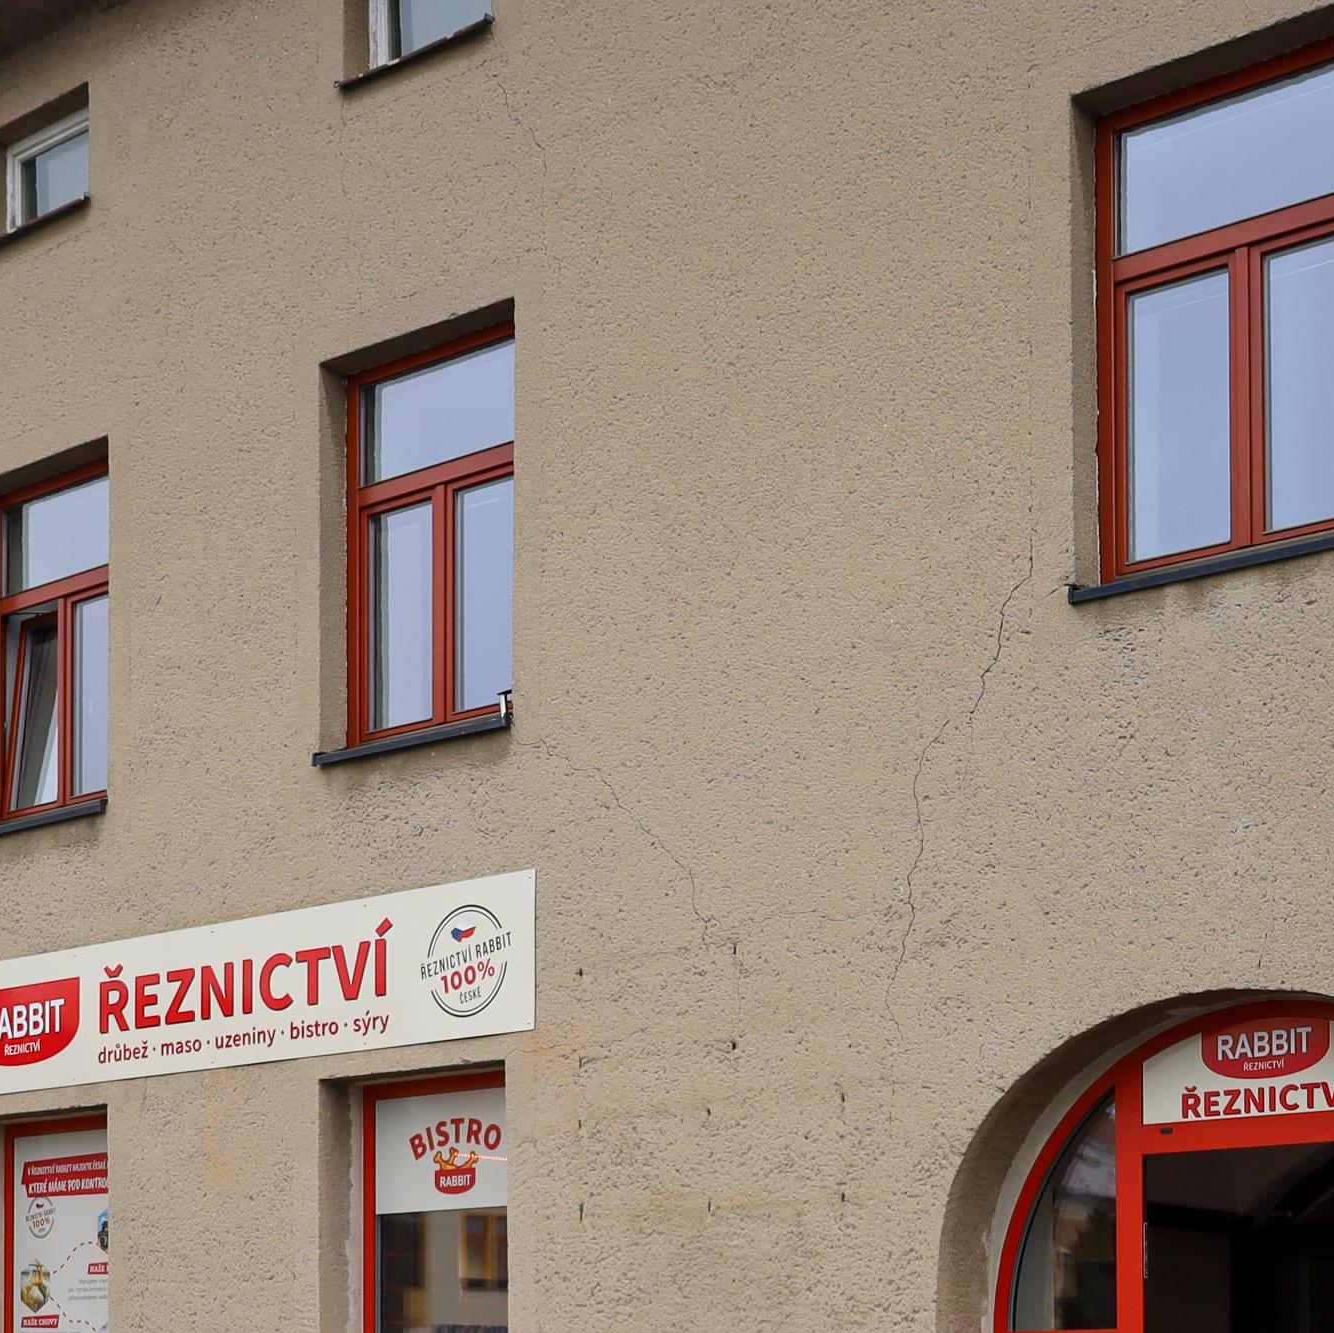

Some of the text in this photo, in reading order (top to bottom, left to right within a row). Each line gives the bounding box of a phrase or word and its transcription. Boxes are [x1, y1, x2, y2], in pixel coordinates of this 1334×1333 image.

[420, 931, 512, 981] ŘEZNICTVÍ RABBIT
[99, 917, 393, 1034] ŘEZNICTVÍ
[441, 957, 496, 994] 100%
[4, 1039, 41, 1057] ŘEZNICTVÍ
[98, 1010, 390, 1064] drůbež maso uzeniny bistro sýry
[1217, 1026, 1312, 1062] RABBIT
[1243, 1058, 1285, 1072] ŘEZNICTVÍ
[409, 1117, 502, 1161] BISTRO
[28, 1179, 47, 1194] KTERÉ
[68, 1179, 80, 1191] POD
[440, 1174, 471, 1187] RABBIT
[32, 1217, 51, 1229] 100%
